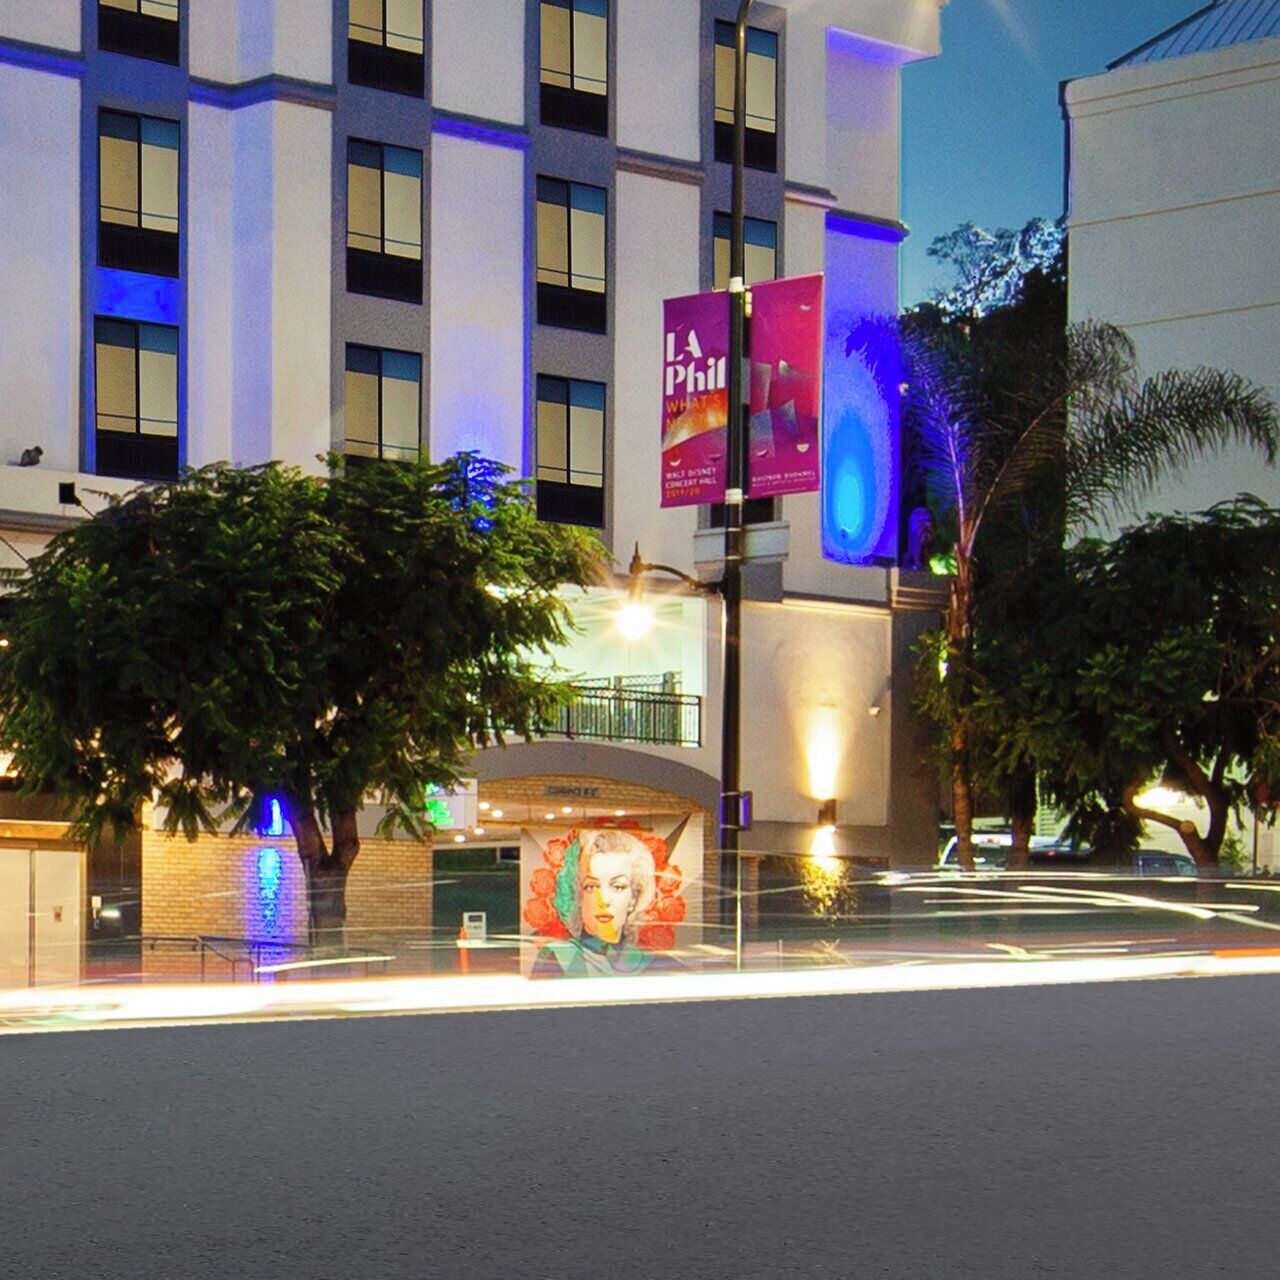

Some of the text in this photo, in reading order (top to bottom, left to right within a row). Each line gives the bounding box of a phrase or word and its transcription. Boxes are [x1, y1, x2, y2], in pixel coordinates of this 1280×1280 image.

[666, 330, 702, 362] LA
[666, 356, 726, 395] Phil
[666, 394, 721, 412] WHAT'S
